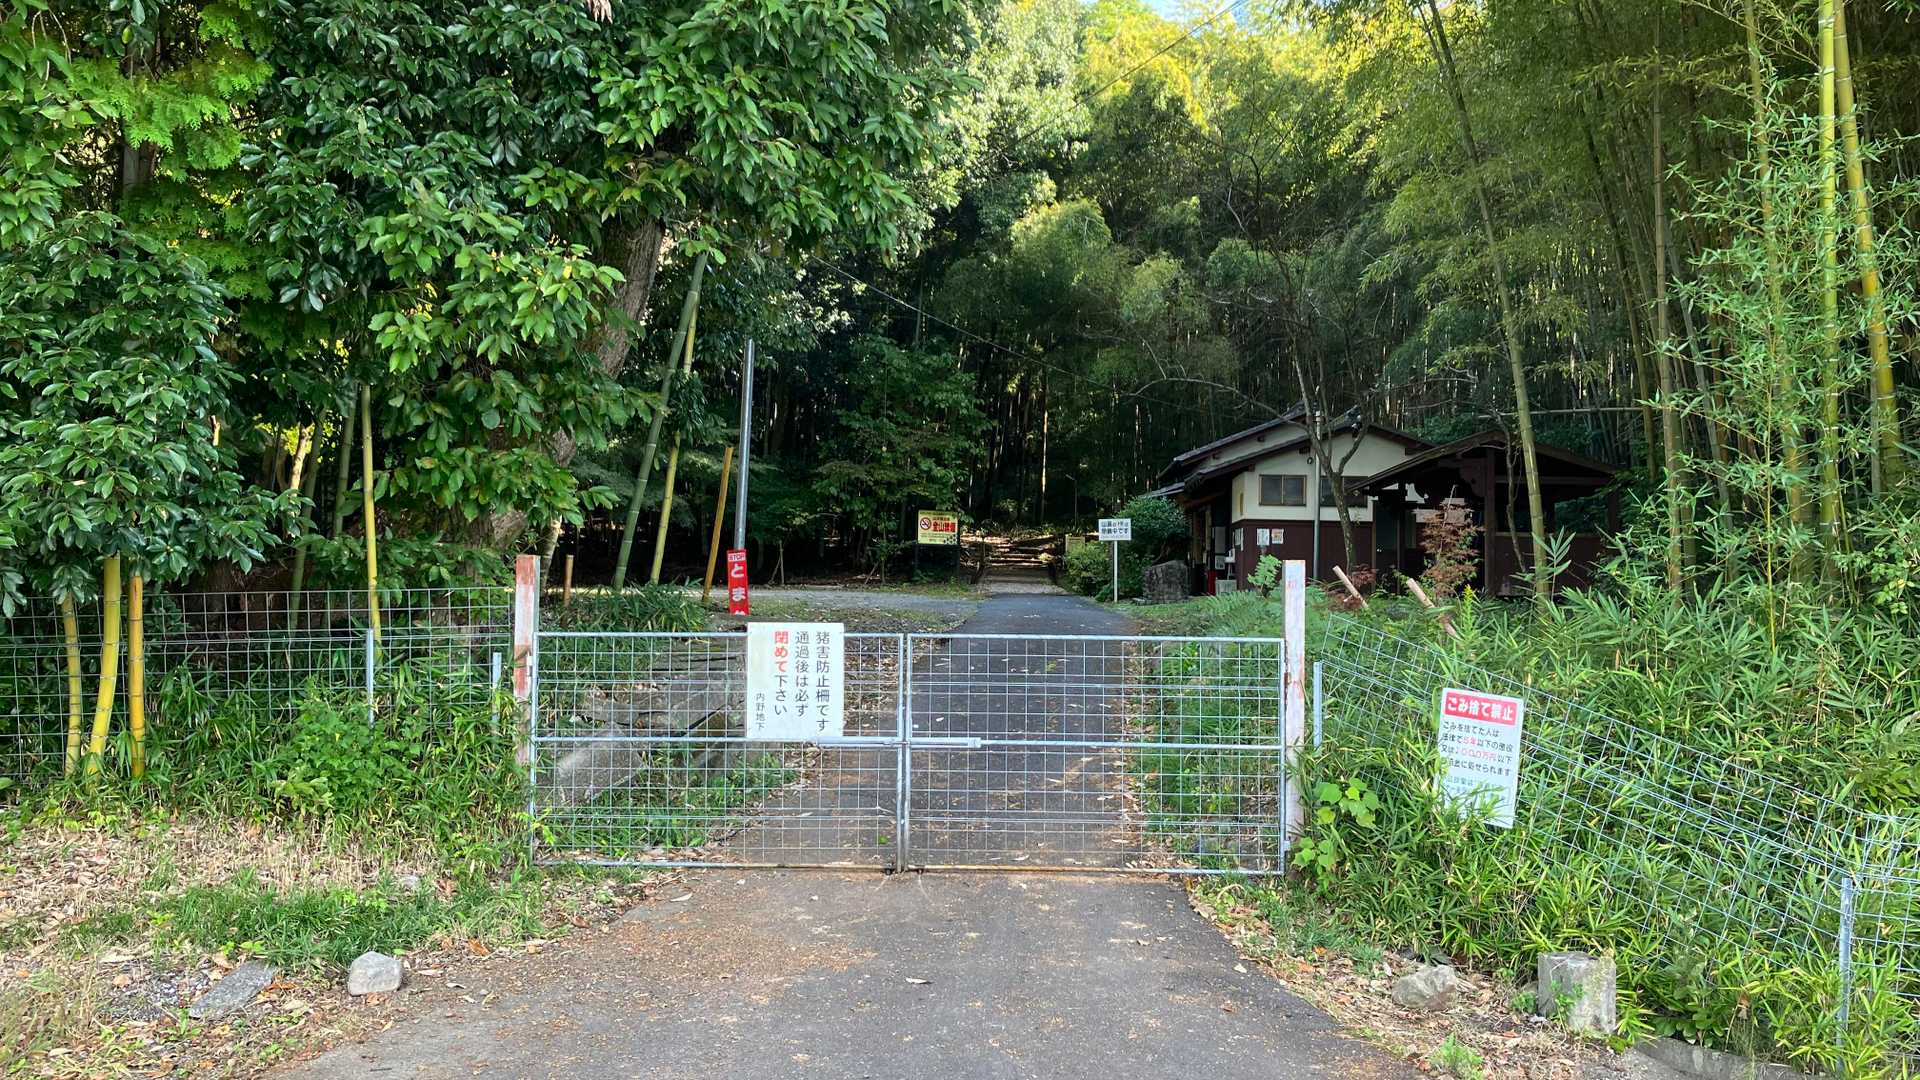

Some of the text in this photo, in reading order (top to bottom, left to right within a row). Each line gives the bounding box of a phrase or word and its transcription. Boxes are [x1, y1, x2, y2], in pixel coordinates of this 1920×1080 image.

[731, 563, 746, 615] とま
[774, 631, 789, 716] 閉めて下さい
[795, 631, 809, 717] 通過後は必ず
[816, 631, 830, 732] 猪害防止柵です
[756, 693, 765, 731] 内野地下
[1447, 697, 1513, 721] ごみ捨て禁止
